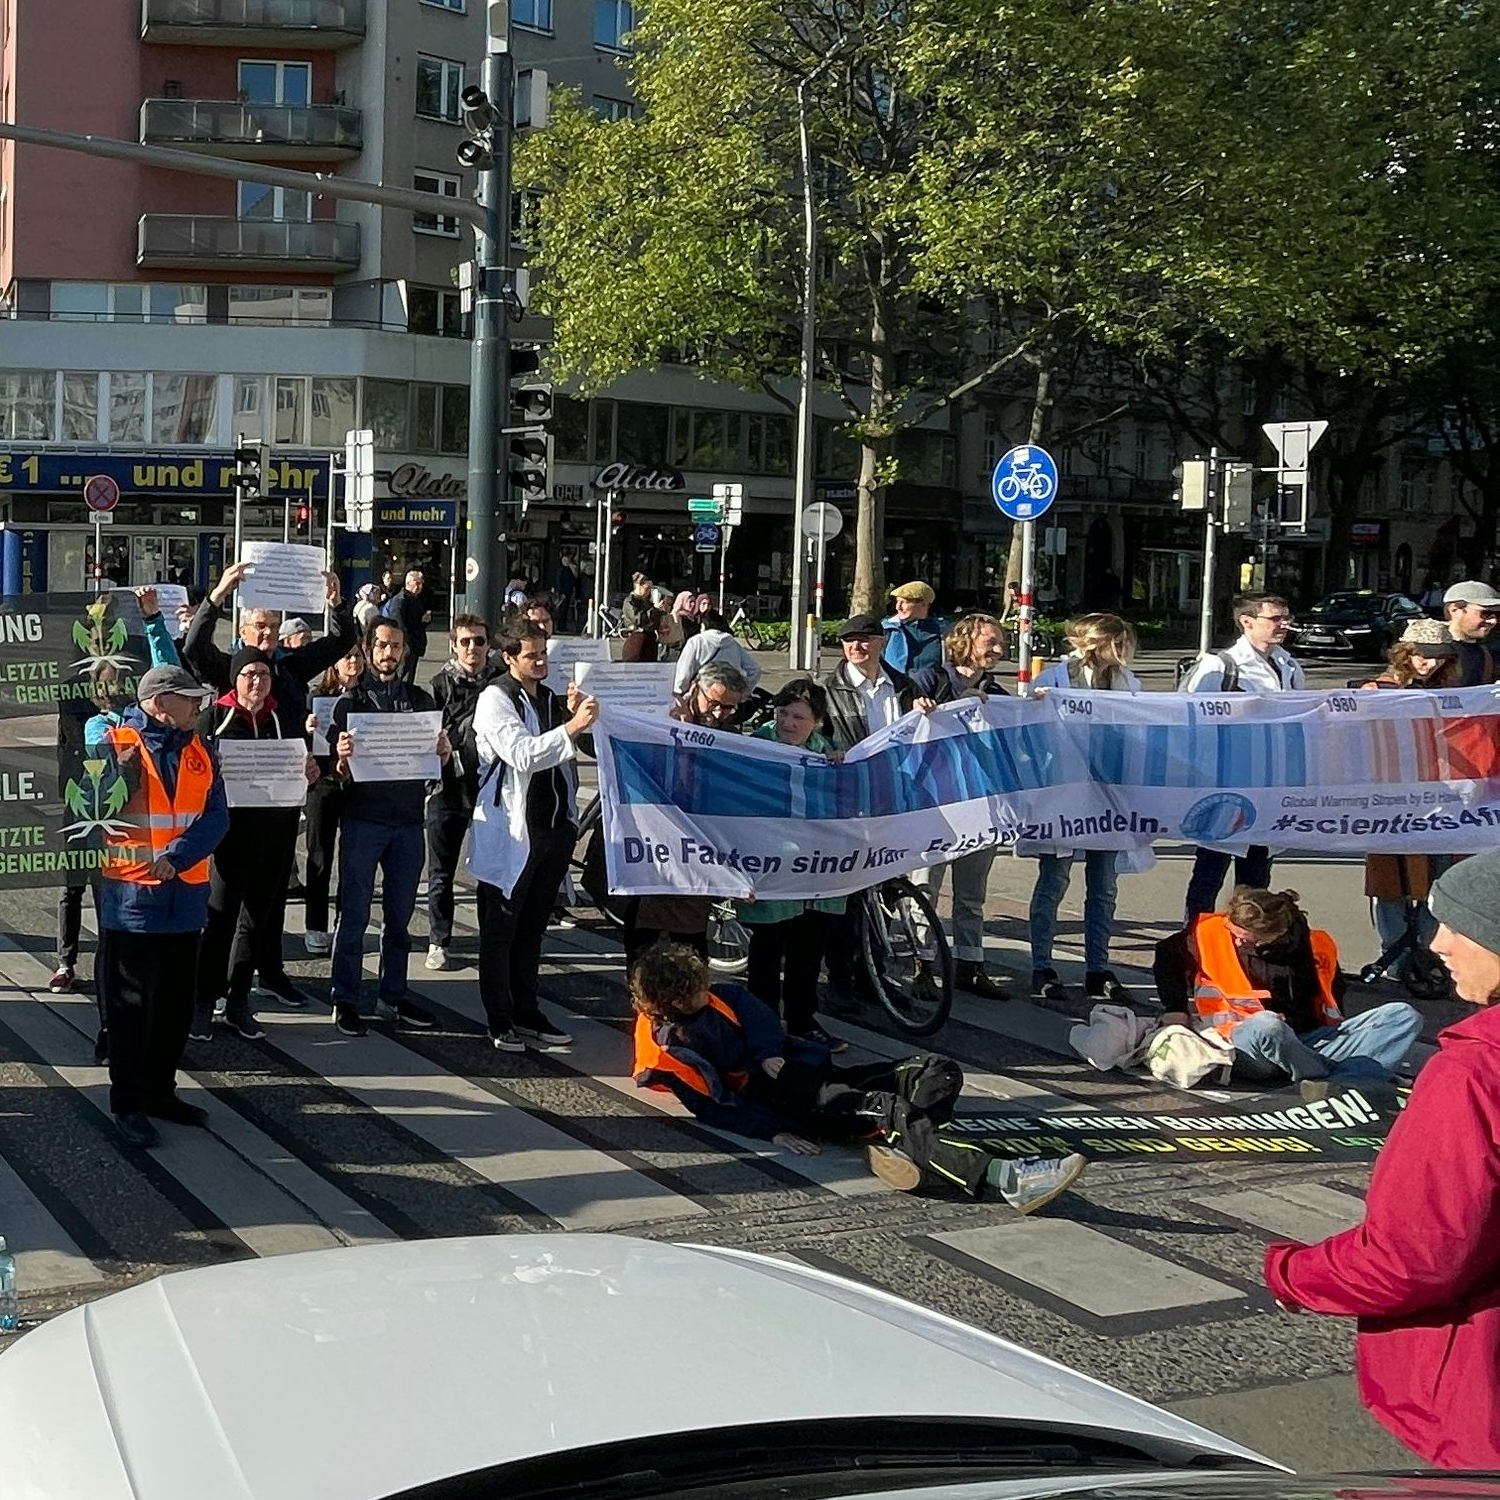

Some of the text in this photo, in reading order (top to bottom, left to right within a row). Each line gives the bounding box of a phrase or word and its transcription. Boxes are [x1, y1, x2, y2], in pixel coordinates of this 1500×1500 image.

[21, 456, 40, 484] 1
[133, 461, 204, 488] und
[381, 506, 446, 520] und mehr
[1061, 699, 1093, 716] 1940
[1200, 700, 1232, 717] 1960
[1326, 696, 1358, 713] 1980
[1281, 795, 1317, 808] Global
[1271, 805, 1500, 836] #scientists4f
[624, 836, 670, 864] Die
[791, 847, 859, 874] sind
[1060, 810, 1169, 838] handeln.
[1039, 1116, 1161, 1131] NEUEN
[1153, 1088, 1381, 1132] BOHRUNGEN!
[1082, 1136, 1178, 1153] SIND
[1175, 1136, 1323, 1153] GENUG!
